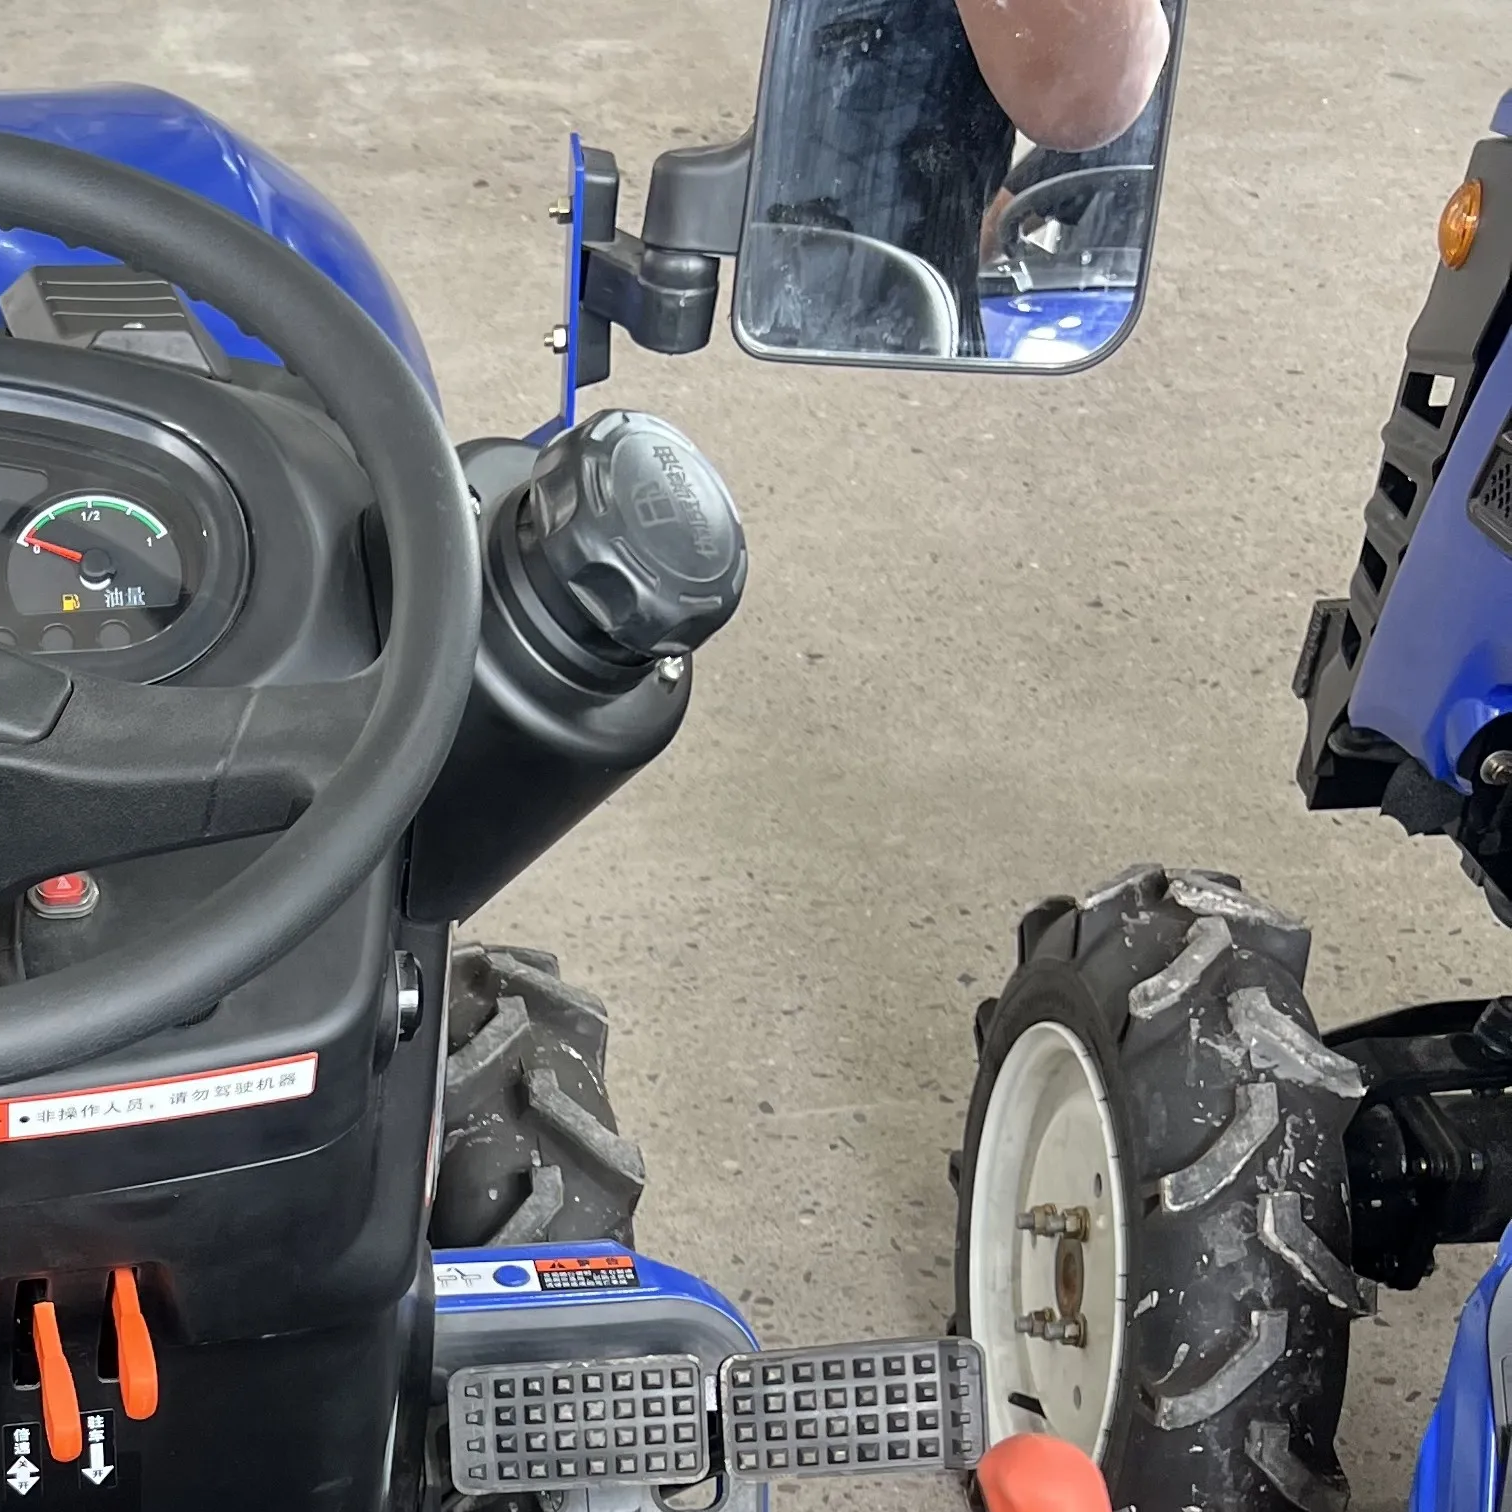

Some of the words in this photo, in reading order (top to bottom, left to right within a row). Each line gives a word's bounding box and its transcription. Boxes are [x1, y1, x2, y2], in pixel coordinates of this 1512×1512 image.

[80, 510, 101, 522] 1/2
[146, 536, 153, 547] 1
[104, 586, 146, 608] 油量
